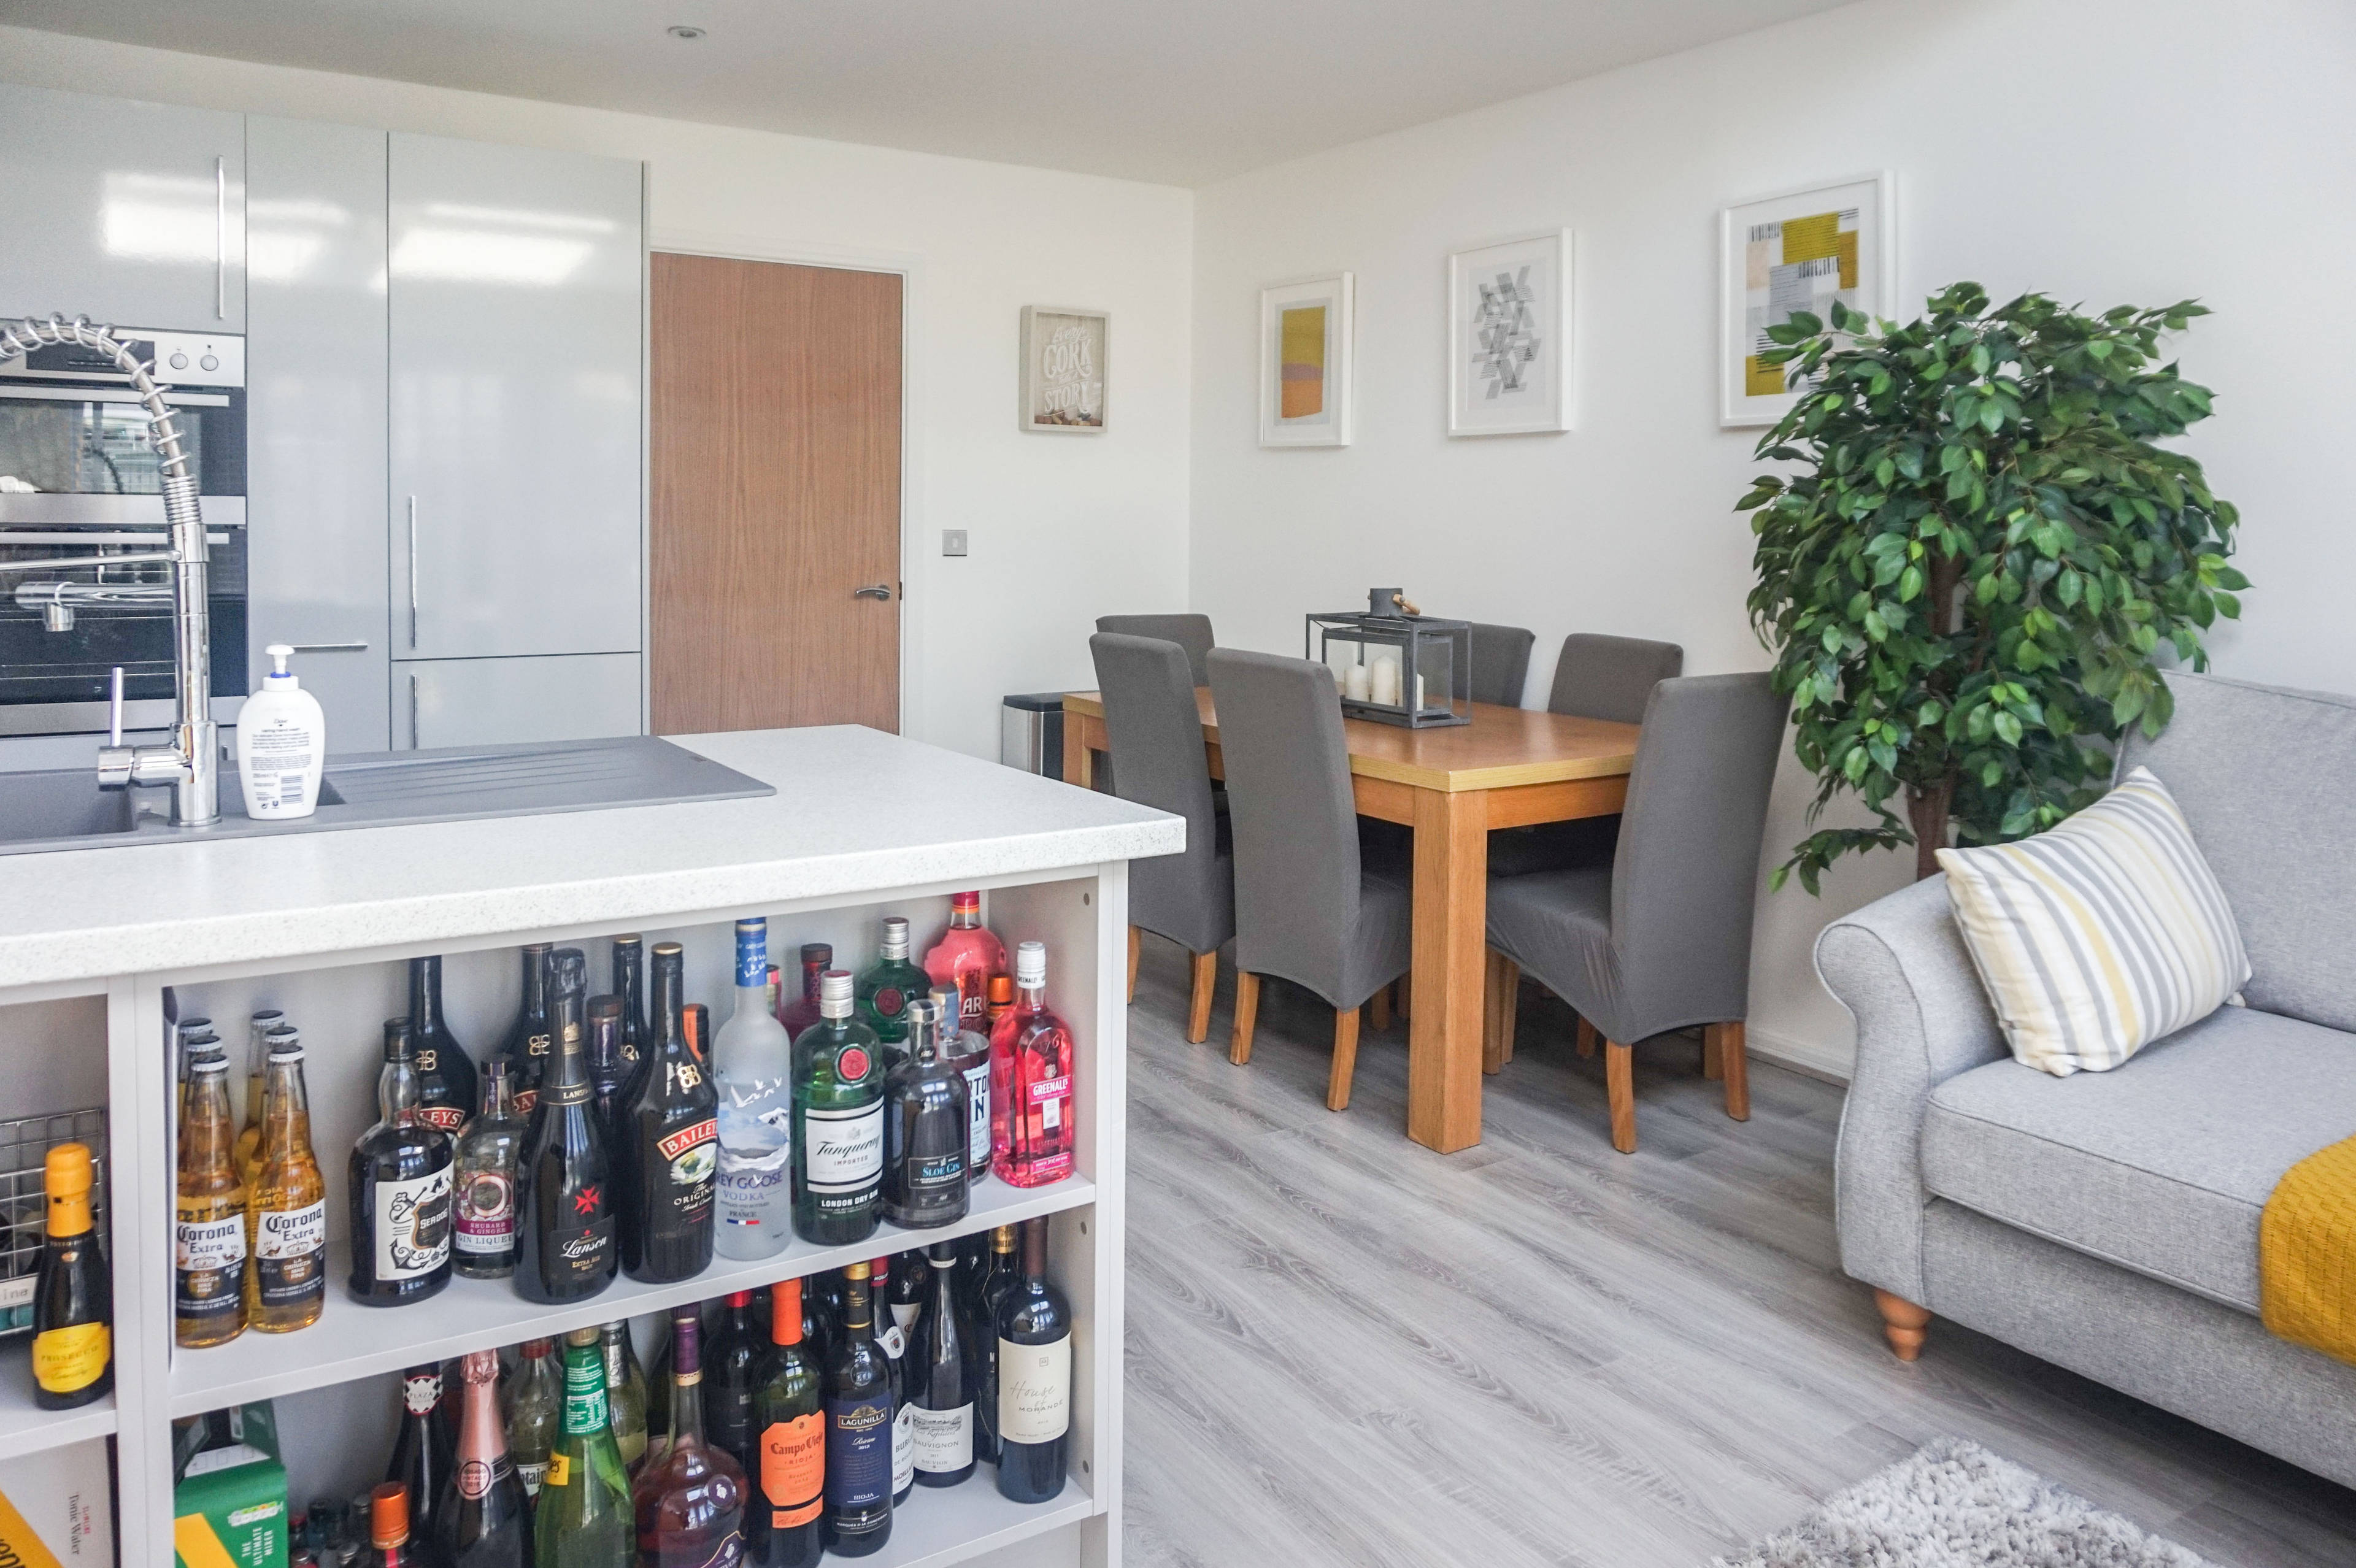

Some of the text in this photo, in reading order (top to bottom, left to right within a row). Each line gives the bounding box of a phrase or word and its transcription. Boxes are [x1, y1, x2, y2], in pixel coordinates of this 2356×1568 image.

[1044, 338, 1093, 379] CORK
[1044, 381, 1091, 413] STORY
[815, 1134, 881, 1159] Tanqueray
[834, 1155, 869, 1166] IMPORTED
[737, 1170, 782, 1189] GOOSE
[922, 1166, 945, 1177] SLOE
[723, 1189, 764, 1201] VODKA
[821, 1188, 879, 1207] LONDON DRY GIN
[266, 1207, 323, 1234] Corona
[177, 1224, 236, 1246] Corona
[283, 1228, 315, 1241] Extra
[190, 1242, 223, 1254] Extra
[559, 1236, 607, 1258] Lanson
[1010, 1381, 1055, 1399] House
[841, 1412, 885, 1426] LAGUNILLA
[771, 1442, 806, 1458] Campo
[913, 1437, 959, 1448] SAUVIGNON
[241, 1541, 252, 1558] THE
[252, 1526, 263, 1566] ULTIMATE
[263, 1529, 274, 1556] MIXER
